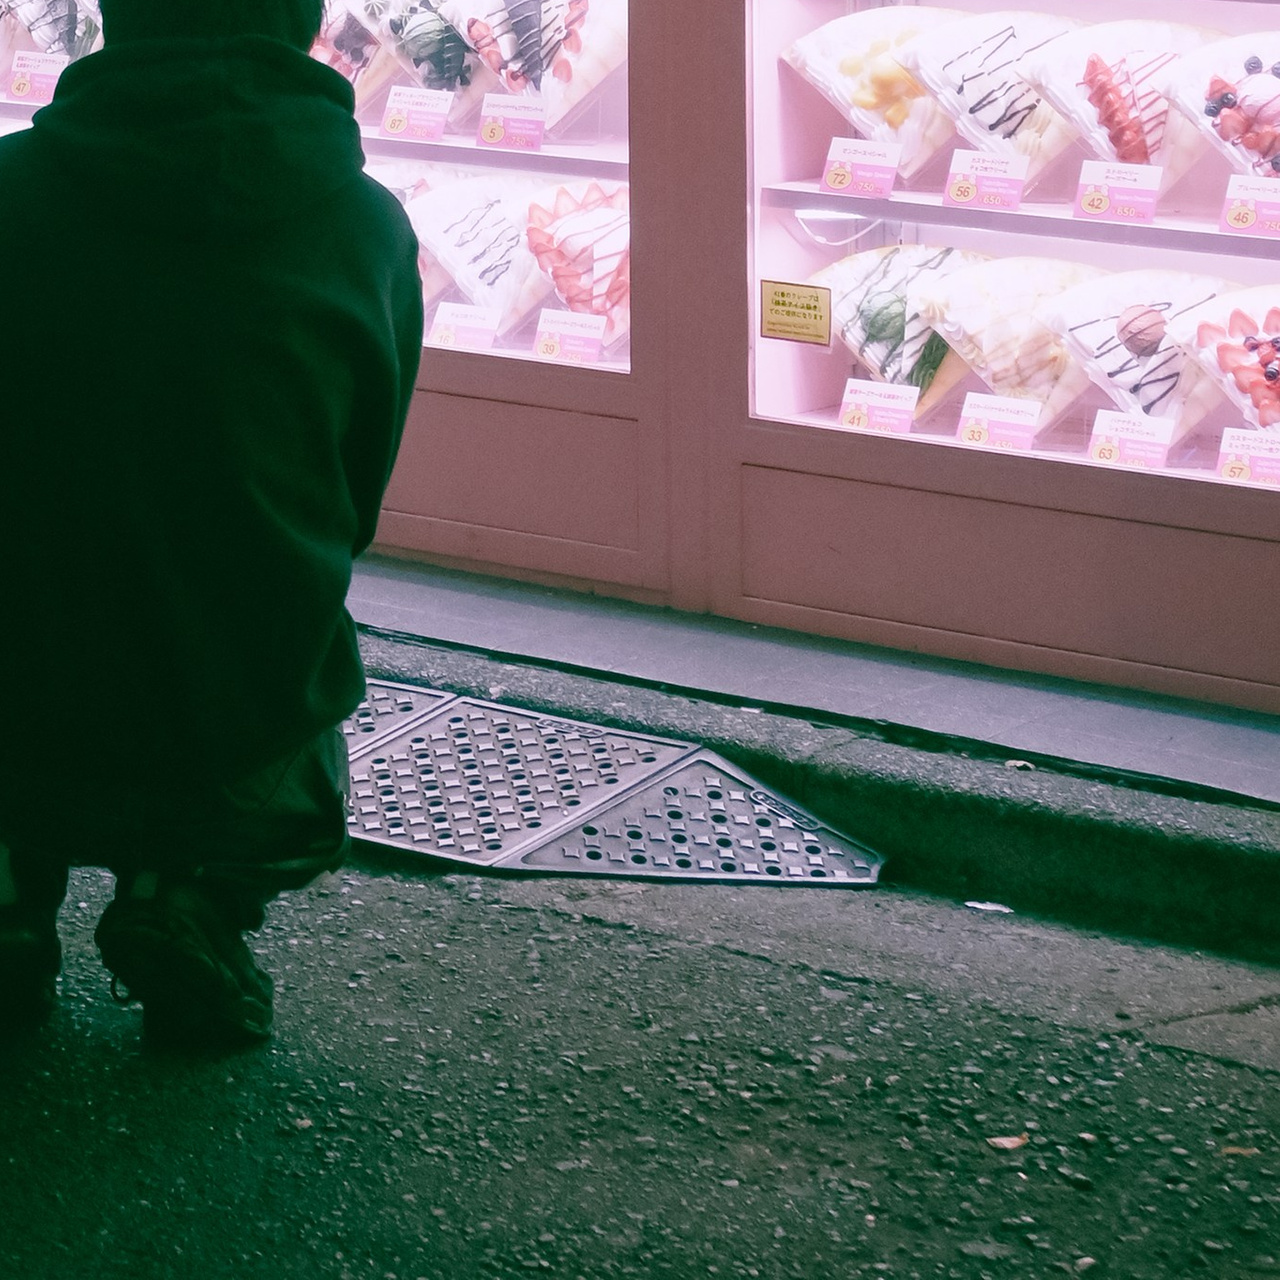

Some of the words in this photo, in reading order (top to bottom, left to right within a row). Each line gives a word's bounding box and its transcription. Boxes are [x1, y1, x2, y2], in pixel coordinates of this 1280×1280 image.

[15, 82, 27, 93] 47
[389, 118, 403, 130] 87
[489, 127, 496, 139] 5
[833, 173, 846, 185] 72
[956, 186, 970, 198] 56
[1088, 198, 1103, 210] 42
[1233, 212, 1249, 224] 46
[542, 342, 555, 355] 39
[848, 415, 862, 427] 41
[967, 430, 982, 442] 33
[1098, 448, 1113, 460] 63
[1229, 467, 1244, 479] 57
